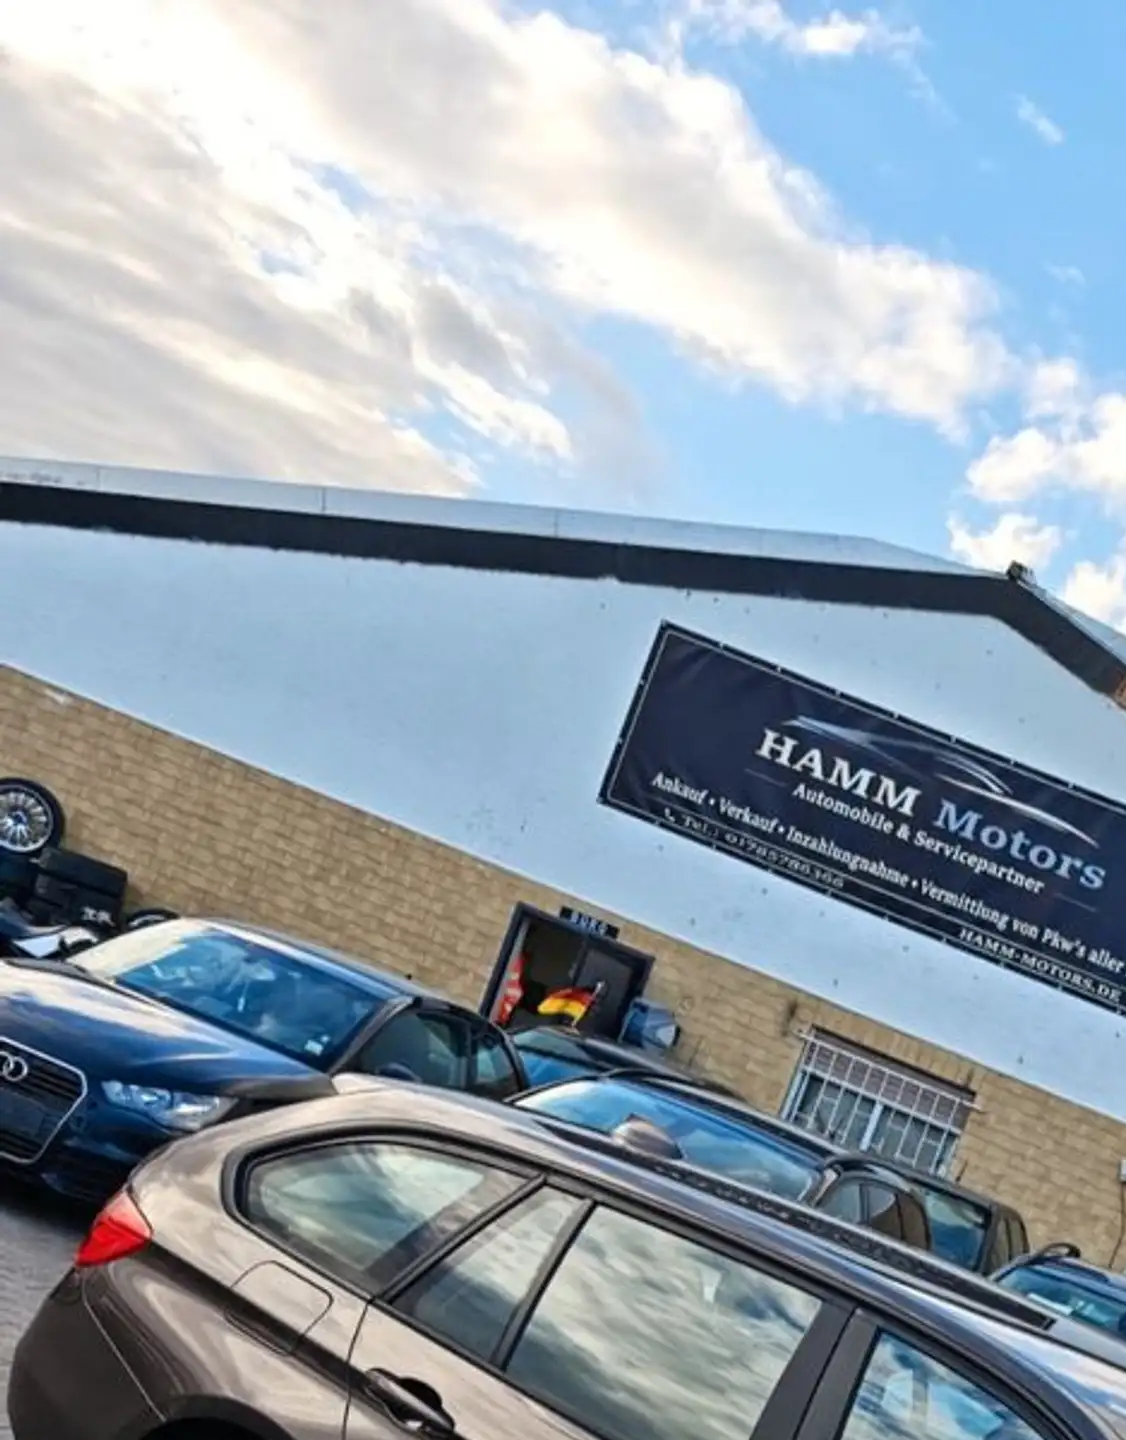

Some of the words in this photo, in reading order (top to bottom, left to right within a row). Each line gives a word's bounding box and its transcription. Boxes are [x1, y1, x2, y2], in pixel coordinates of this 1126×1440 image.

[652, 771, 709, 805] Ankauf
[718, 796, 779, 835] Verkauf
[786, 826, 909, 889] Inzahlungnahme
[920, 877, 1011, 932] Vermittlung
[1012, 917, 1039, 941] von
[1042, 928, 1087, 959] Pkw's
[1088, 947, 1125, 975] aller
[756, 729, 922, 817] HAMM
[934, 799, 1106, 890] Motors
[792, 782, 894, 834] Automobile
[896, 823, 911, 842] &
[914, 830, 1045, 895] Servicepartner
[958, 927, 1123, 1003] HAMM-MOTORS.DE
